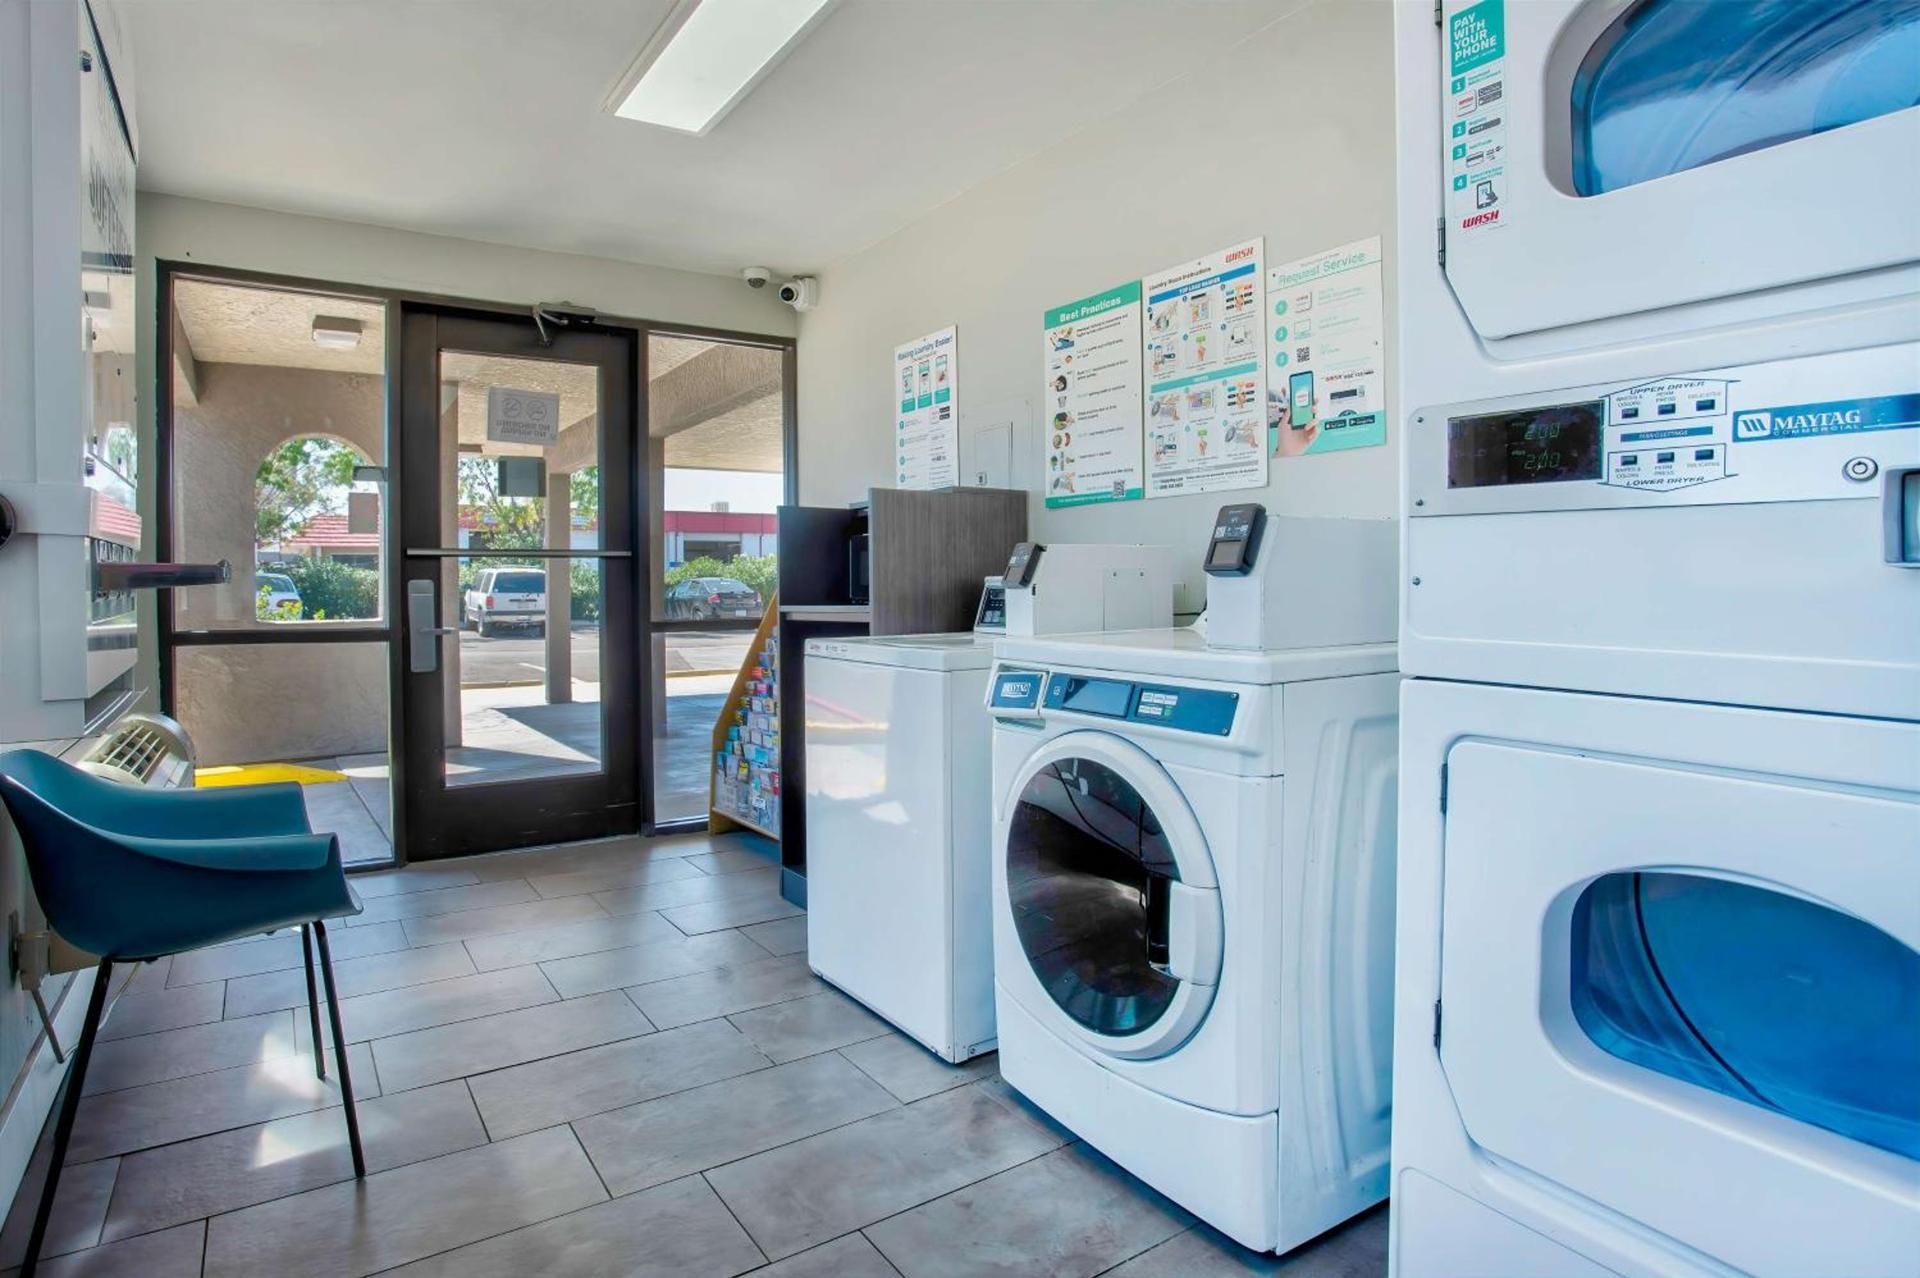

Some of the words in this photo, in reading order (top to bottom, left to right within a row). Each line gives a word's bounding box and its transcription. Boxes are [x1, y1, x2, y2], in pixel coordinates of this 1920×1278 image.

[1454, 12, 1476, 31] PAY
[1454, 19, 1486, 41] WITH
[1454, 29, 1488, 50] YOUR
[1455, 35, 1498, 62] PHONE
[1462, 209, 1500, 229] WASH
[1225, 246, 1254, 263] WASH
[1278, 265, 1320, 286] Request
[1323, 251, 1366, 273] Service
[1059, 308, 1079, 322] Best
[1080, 296, 1122, 317] Practices
[1630, 386, 1665, 395] UPPER
[1667, 381, 1705, 391] DRYER
[1773, 409, 1861, 430] MAYTAG
[1773, 422, 1860, 436] COMMERCIAL
[1626, 478, 1665, 486] LOWER
[1667, 476, 1705, 485] DRYER
